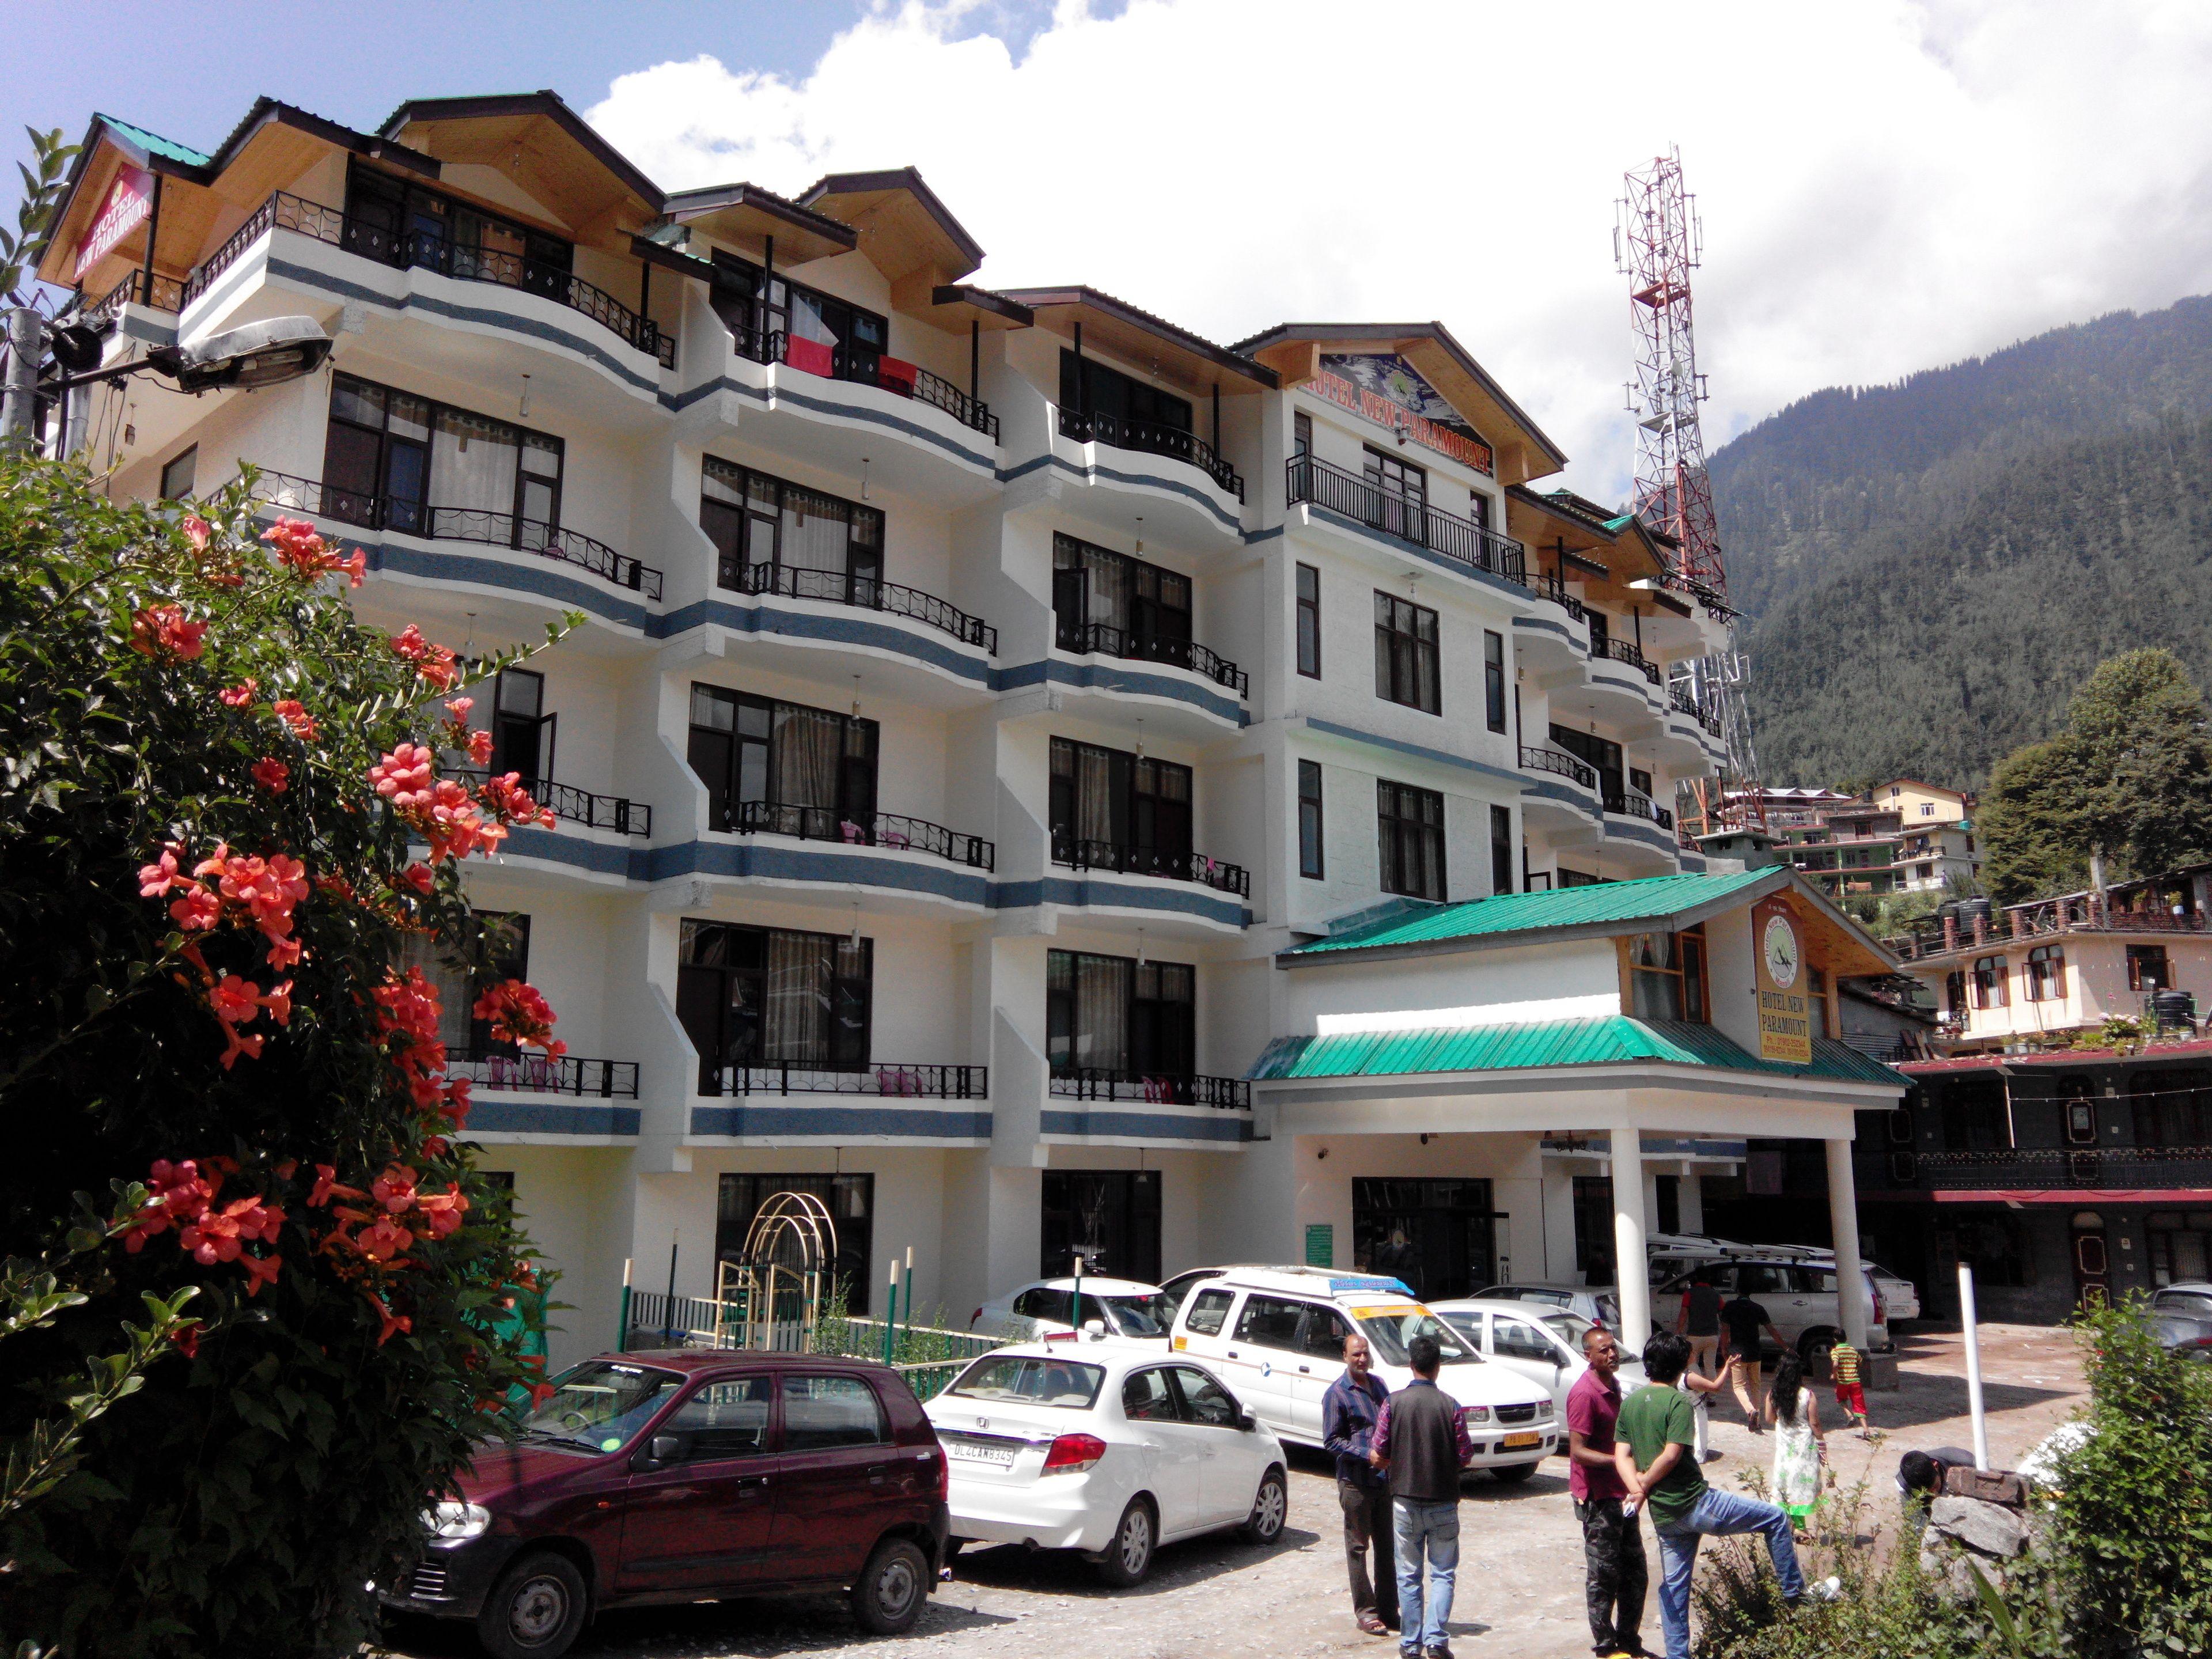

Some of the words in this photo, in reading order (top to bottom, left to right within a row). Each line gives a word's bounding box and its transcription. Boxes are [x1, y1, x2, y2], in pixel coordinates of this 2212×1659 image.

[74, 242, 96, 279] NEW
[94, 192, 150, 260] PARAMOUNT
[92, 191, 135, 243] HOTEL
[1300, 366, 1357, 411] OTEL
[1359, 387, 1396, 429] NEW
[1400, 407, 1490, 472] PARAMOUNT
[1762, 991, 1786, 1011] HOTEL
[1788, 995, 1804, 1014] NEW
[1762, 1014, 1806, 1037] PARAMOUNT
